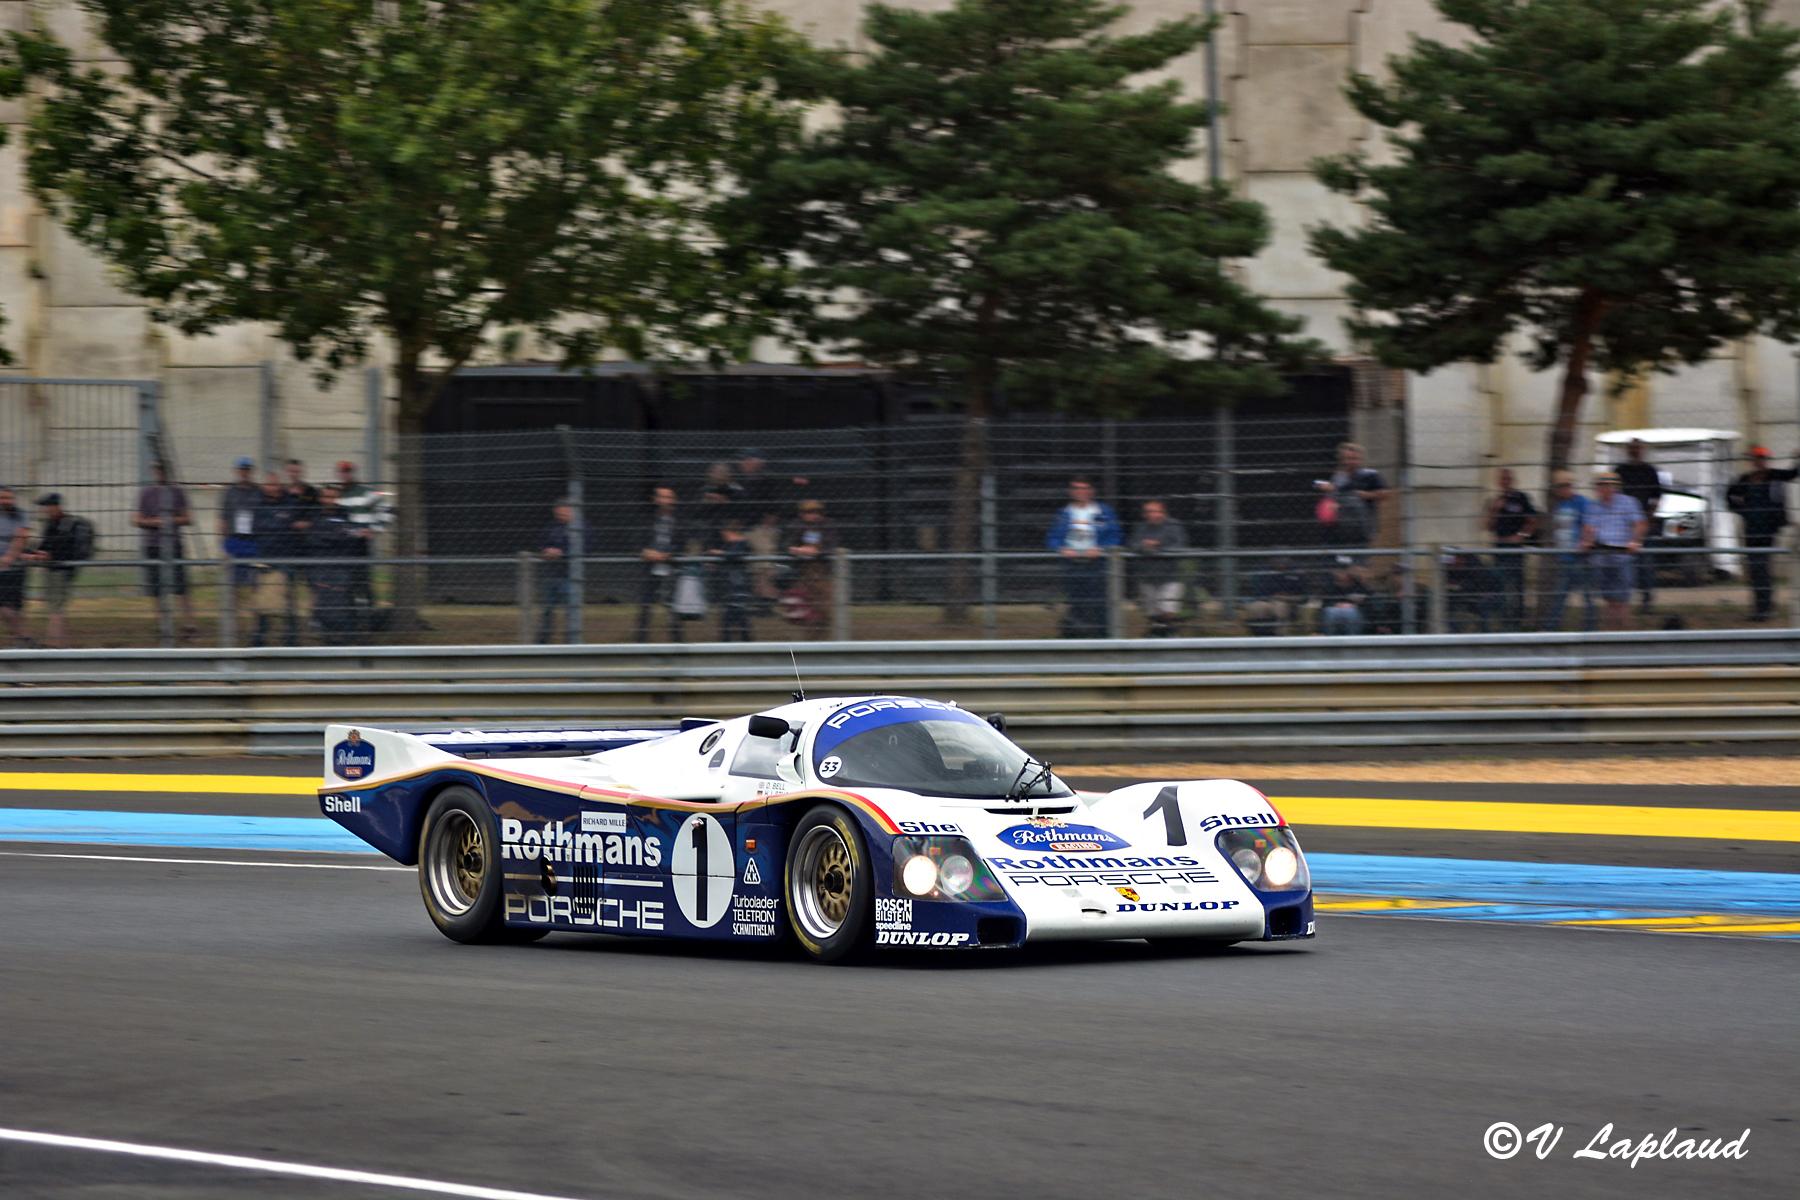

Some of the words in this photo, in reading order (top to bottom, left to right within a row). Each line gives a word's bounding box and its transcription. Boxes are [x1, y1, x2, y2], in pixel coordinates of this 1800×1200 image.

[822, 762, 839, 772] 33
[325, 796, 361, 813] Shell
[582, 814, 608, 826] RICHARD
[608, 815, 625, 827] MILLE
[1143, 786, 1187, 846] 1
[1200, 813, 1277, 832] Shell
[500, 818, 662, 867] Rothmans
[1012, 829, 1117, 845] Rothmans
[692, 817, 708, 921] 1
[986, 855, 1199, 870] Rothmans
[1009, 871, 1219, 887] PORSCHE
[732, 894, 779, 909] Turbolader
[875, 898, 913, 911] BOSCH
[1116, 900, 1240, 913] DUNLOP
[504, 893, 664, 930] PORSCHE
[732, 908, 775, 923] TELETRON
[875, 910, 913, 922] BILSTEIN
[875, 921, 912, 931] speedline
[876, 931, 970, 946] DUNLOP
